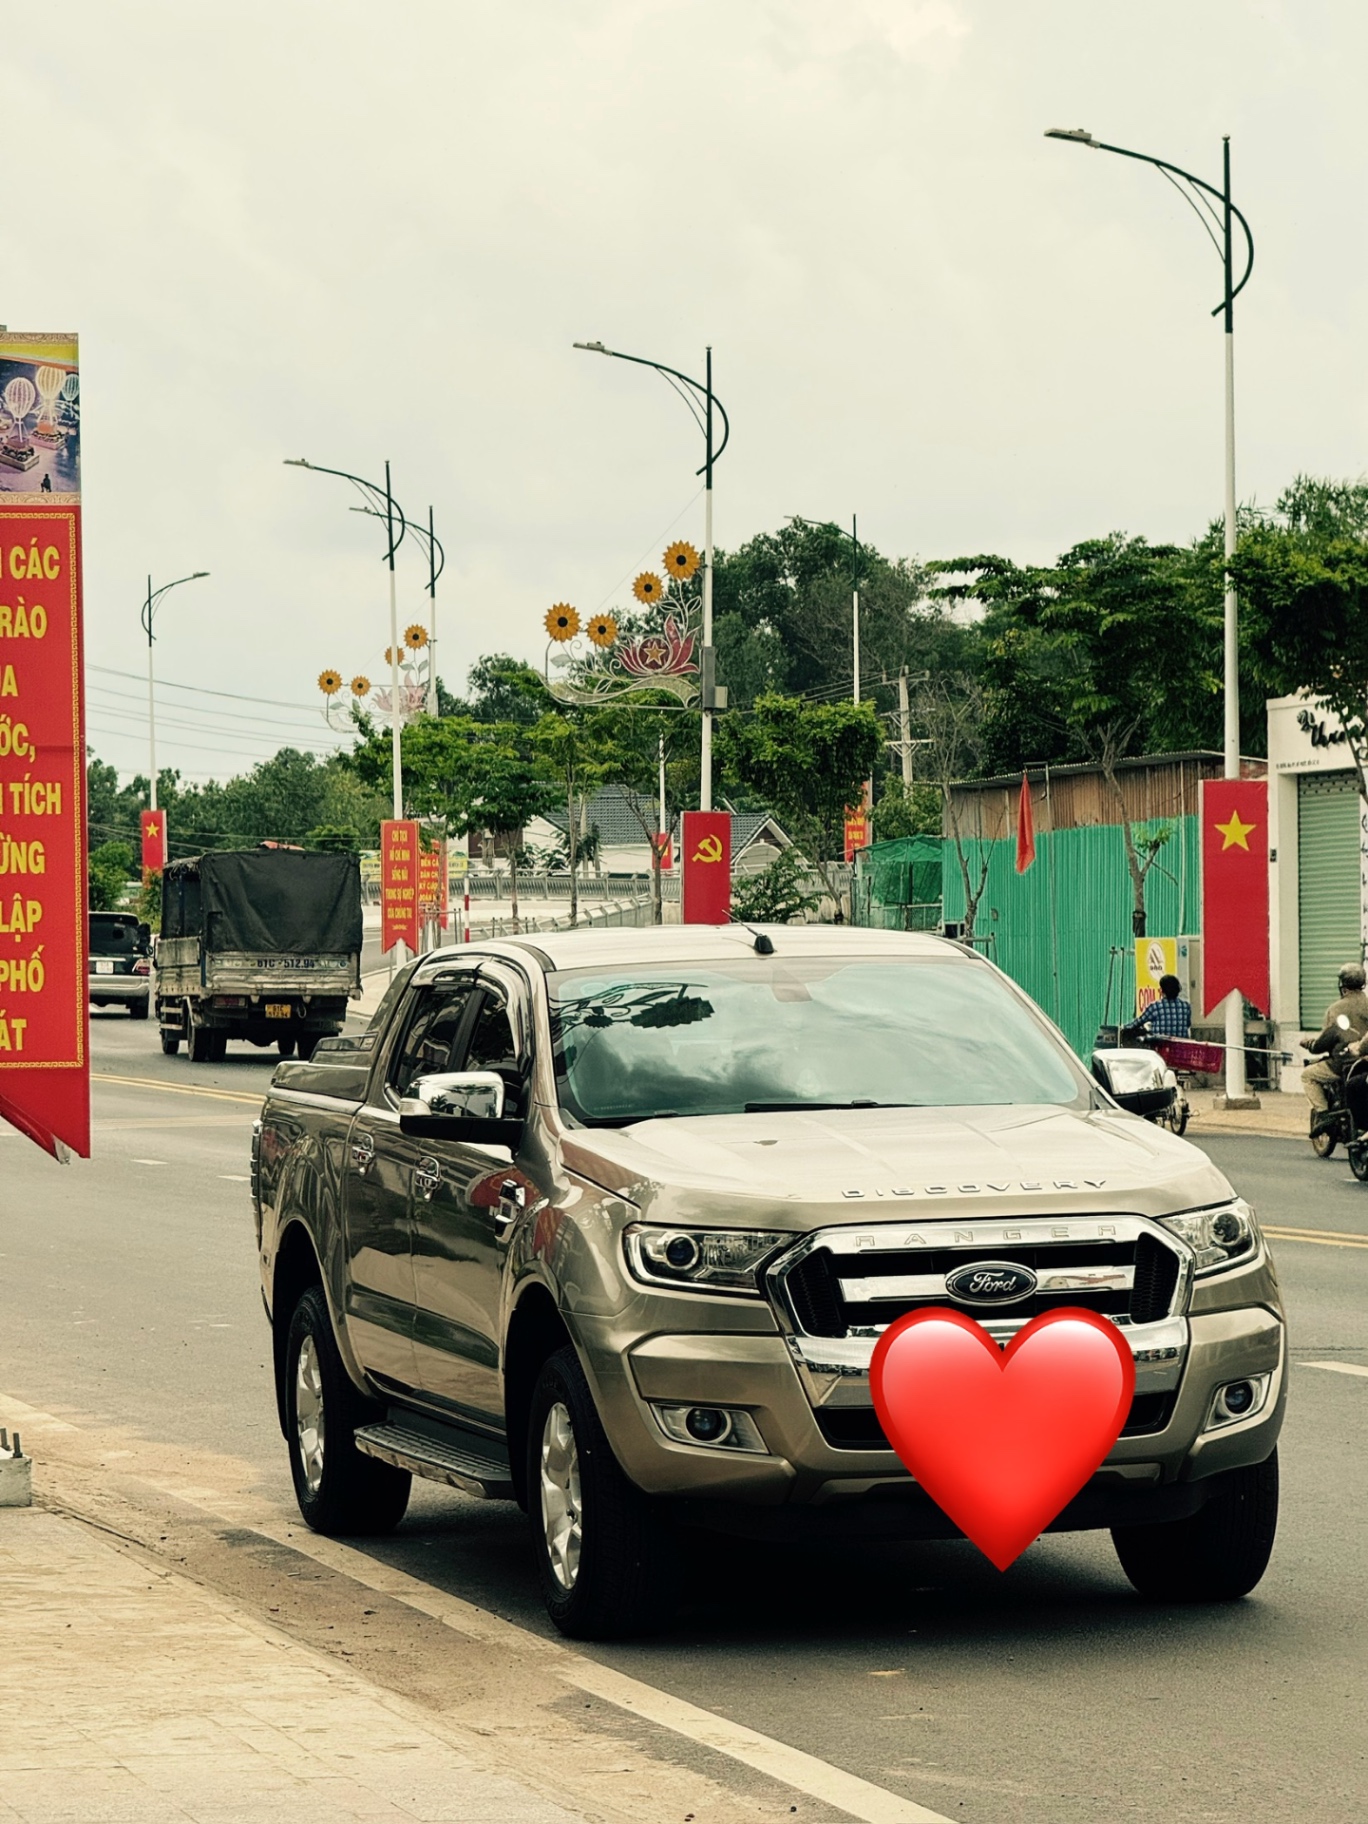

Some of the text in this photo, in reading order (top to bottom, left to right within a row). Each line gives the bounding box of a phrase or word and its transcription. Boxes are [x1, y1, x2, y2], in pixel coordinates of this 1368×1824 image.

[9, 537, 60, 580] CÁC
[0, 596, 47, 639] RÀO
[0, 664, 19, 697] A
[9, 772, 62, 816] TÍCH
[0, 892, 42, 943] LẬP
[0, 944, 45, 992] PHỐ
[841, 1179, 1107, 1199] DISCOVERY
[855, 1225, 1117, 1247] RANGER
[969, 1271, 1017, 1293] Ford
